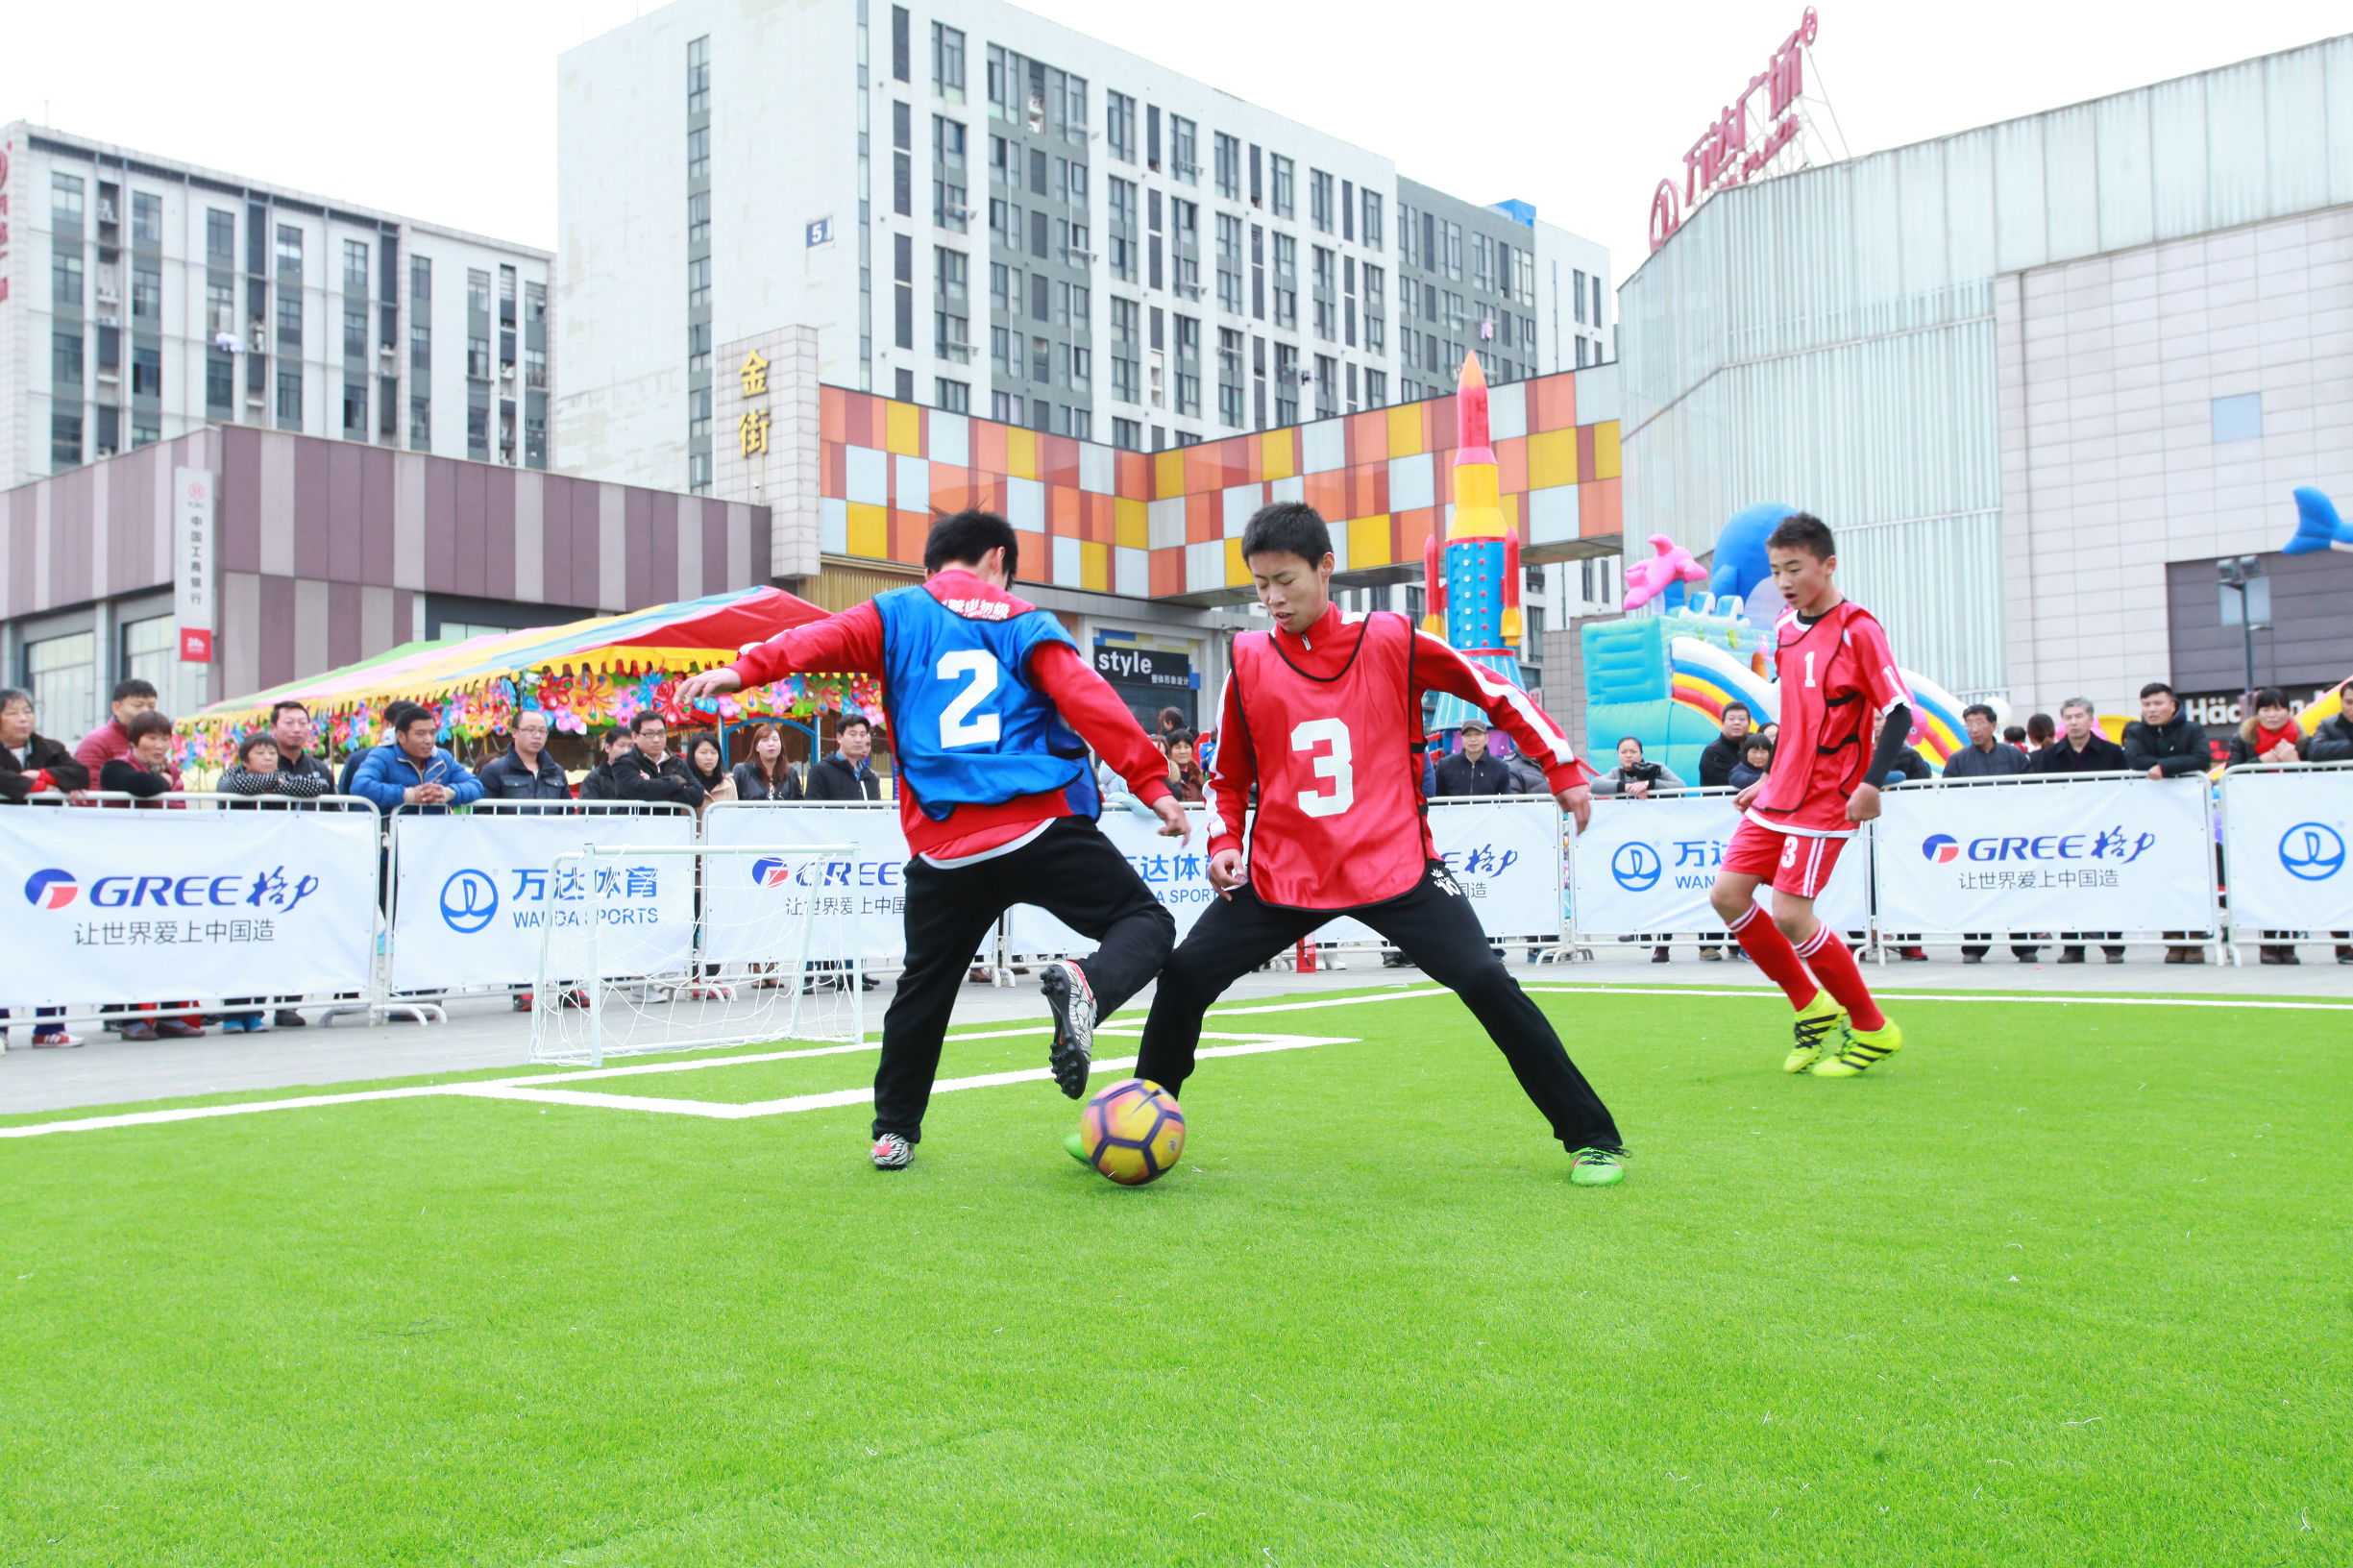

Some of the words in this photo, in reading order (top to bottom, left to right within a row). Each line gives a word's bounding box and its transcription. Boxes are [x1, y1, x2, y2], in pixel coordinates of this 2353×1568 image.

[811, 223, 822, 244] 5
[738, 349, 771, 458] 金街
[190, 515, 203, 605] 中国工商银行
[1098, 650, 1152, 677] style
[1804, 651, 1816, 687] 1
[937, 649, 1000, 748] 2
[1290, 718, 1354, 818] 3
[1780, 835, 1799, 869] 3
[1968, 835, 2086, 862] GREE
[89, 876, 243, 907] GREE
[1958, 869, 2120, 890] 让世界爱上中国造
[585, 907, 659, 925] PORTS
[74, 919, 275, 945] 让世界爱上中国造
